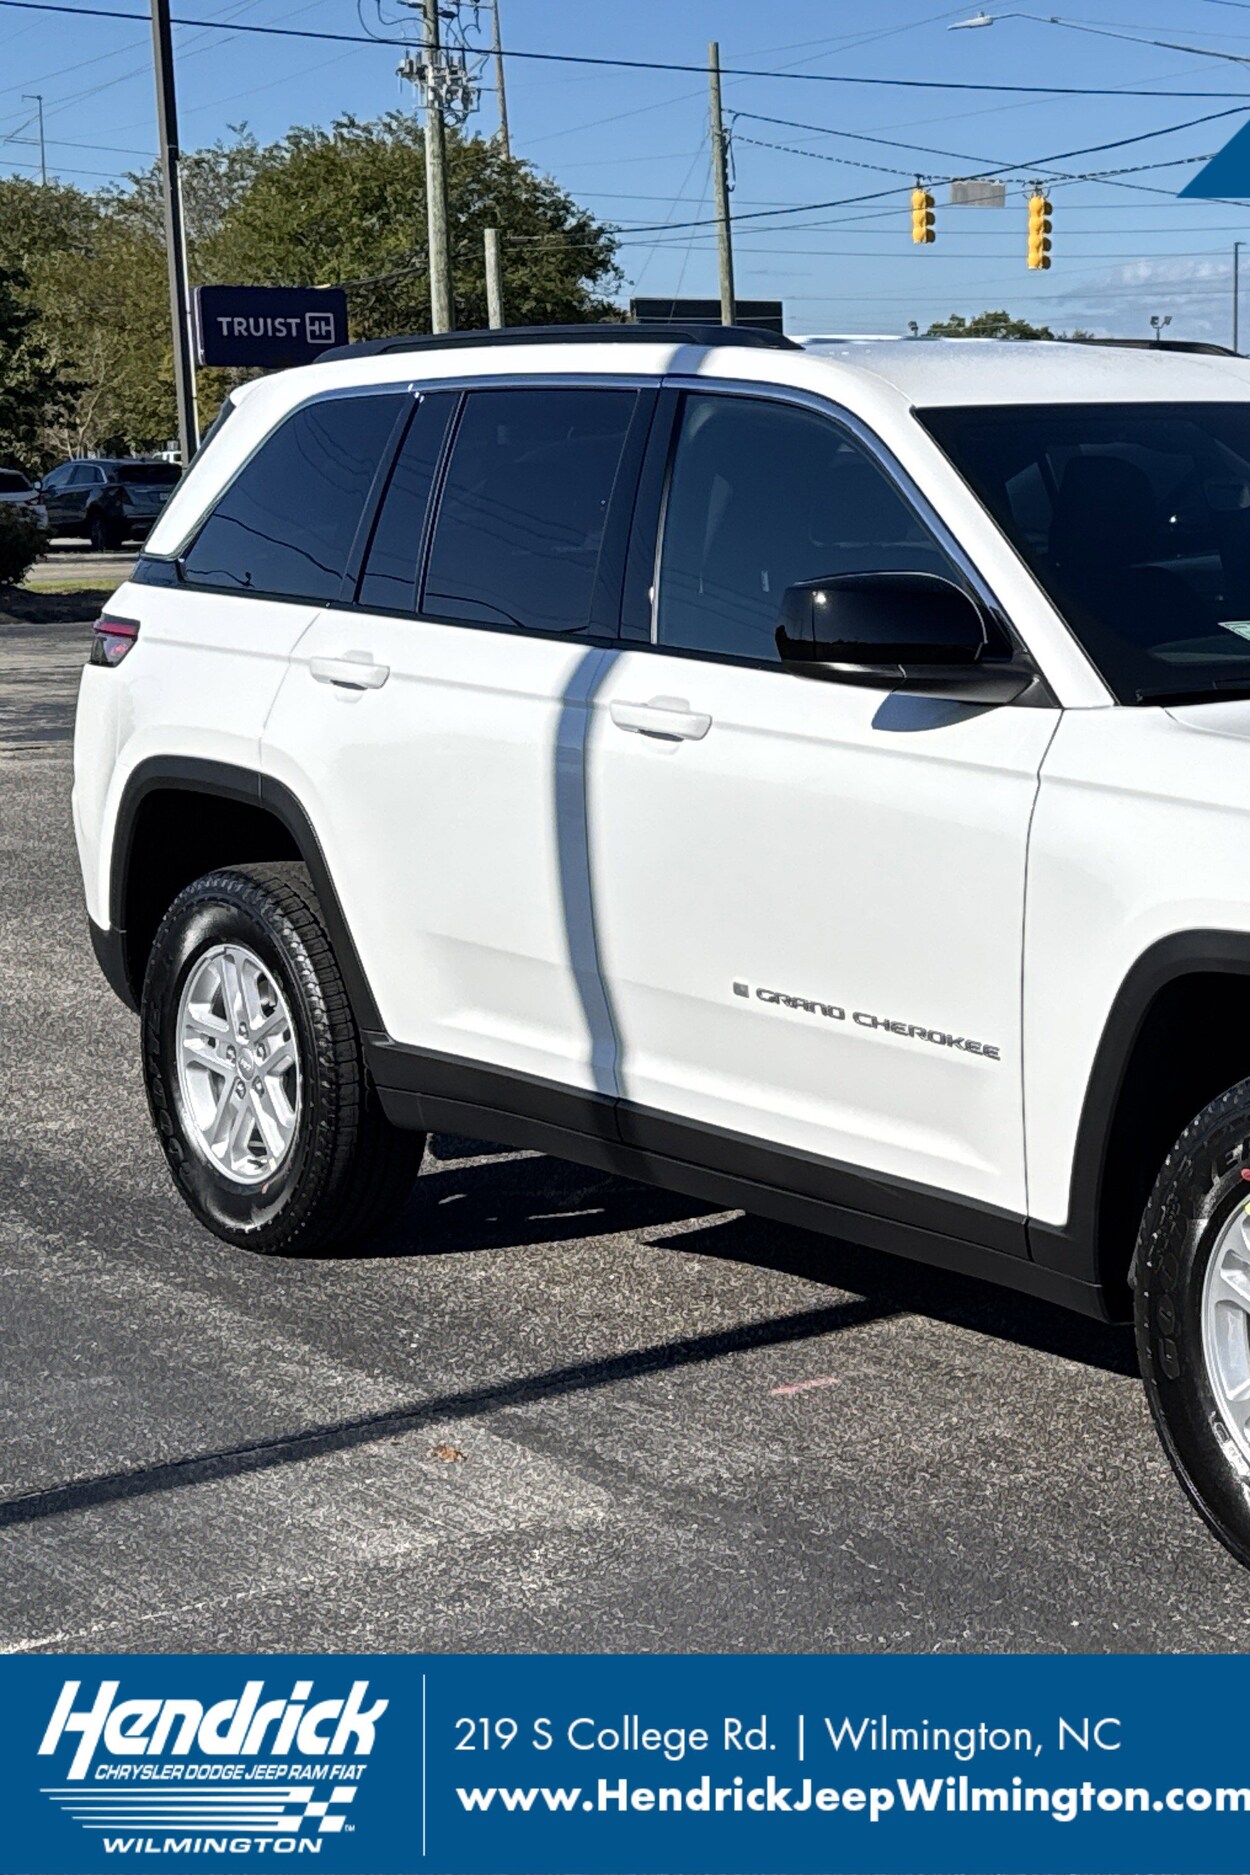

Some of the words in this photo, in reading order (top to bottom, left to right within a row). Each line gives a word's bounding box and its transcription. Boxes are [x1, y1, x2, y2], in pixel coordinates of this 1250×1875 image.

[216, 316, 301, 338] TRUIST
[755, 987, 846, 1022] GRAND
[852, 1011, 1001, 1061] CHEROKEE
